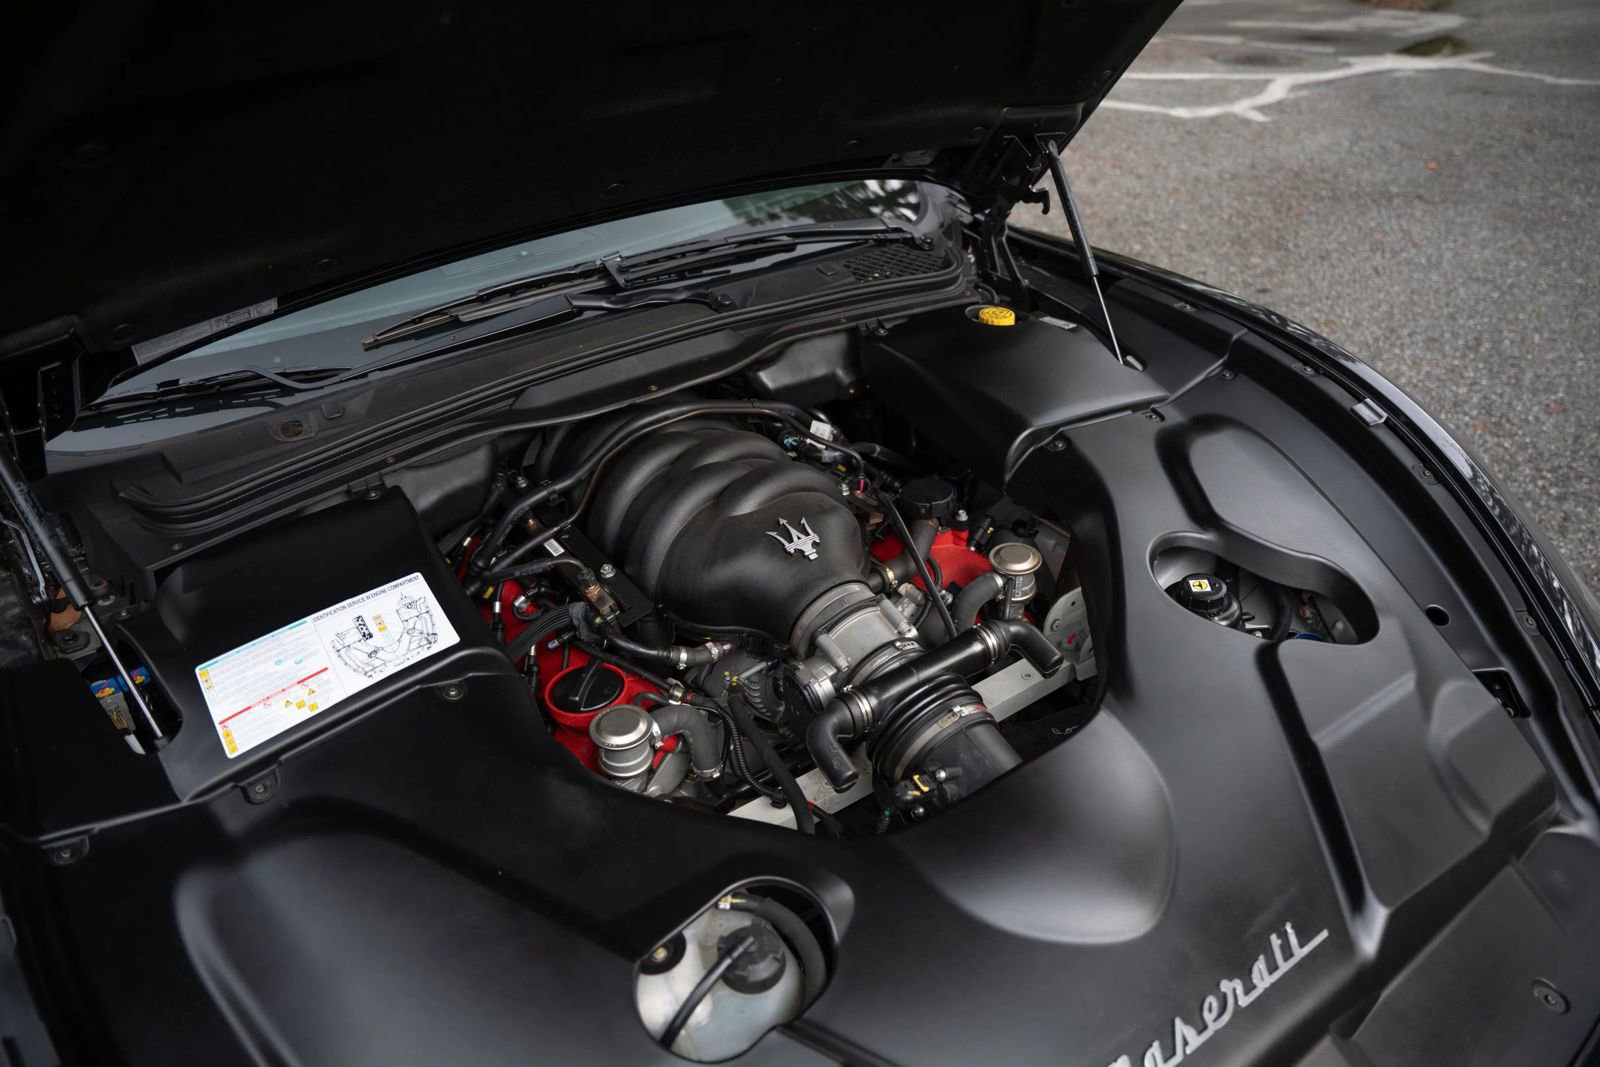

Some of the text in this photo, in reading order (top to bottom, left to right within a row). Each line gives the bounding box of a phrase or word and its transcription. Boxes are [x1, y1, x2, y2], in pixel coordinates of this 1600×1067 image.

[313, 605, 347, 622] IDENTIFICATION
[347, 596, 366, 608] SERVICE
[370, 587, 387, 599] ENGINE
[387, 575, 420, 592] COMPARTMENT
[1107, 921, 1330, 1067] aserati
